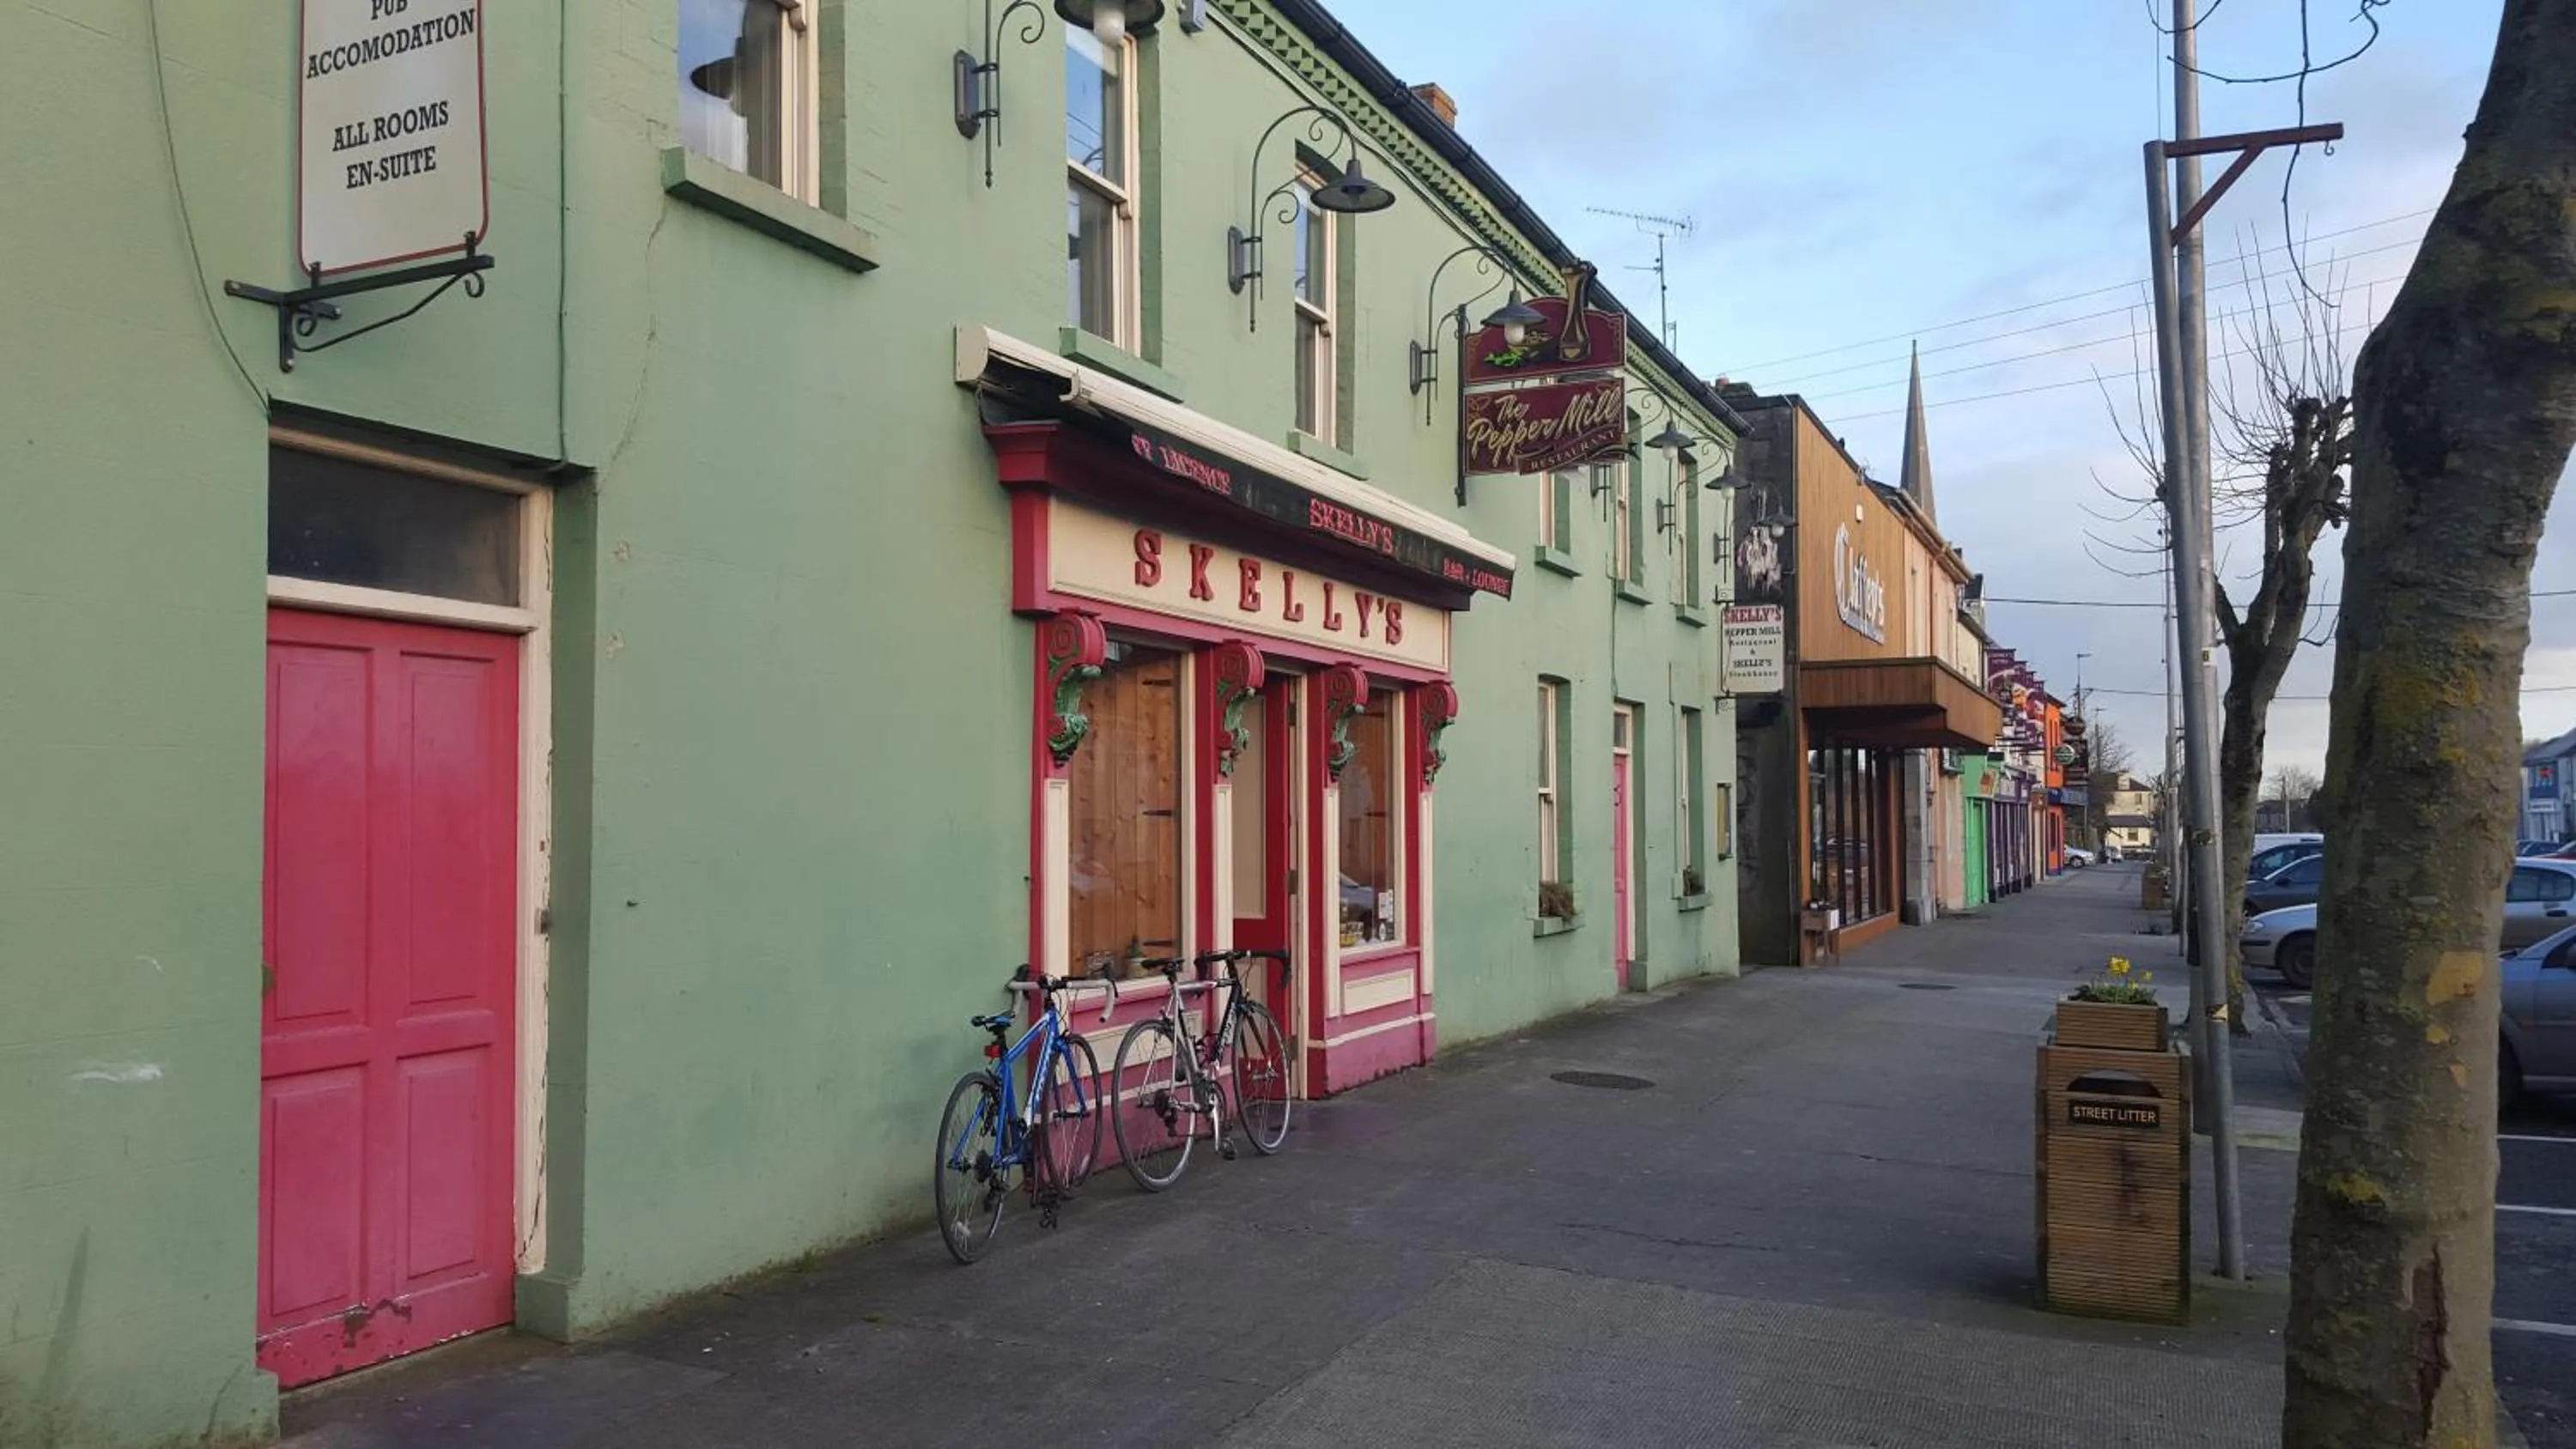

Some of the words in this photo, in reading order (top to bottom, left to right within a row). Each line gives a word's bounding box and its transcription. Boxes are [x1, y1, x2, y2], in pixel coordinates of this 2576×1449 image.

[371, 0, 408, 21] PUB
[307, 8, 476, 78] ACCOMODATION
[332, 122, 369, 151] ALL
[374, 100, 449, 142] ROOMS
[346, 146, 436, 189] EN-SUITE
[1466, 417, 1559, 468] Pepper
[1554, 386, 1622, 440] Mill
[1494, 394, 1530, 424] The
[1309, 495, 1393, 555] SKELLY'S
[1134, 527, 1403, 645] SKELLY'S
[1724, 606, 1782, 624] SKELLY'S
[2073, 1106, 2117, 1120] STREET
[2118, 1108, 2157, 1124] LITTER
